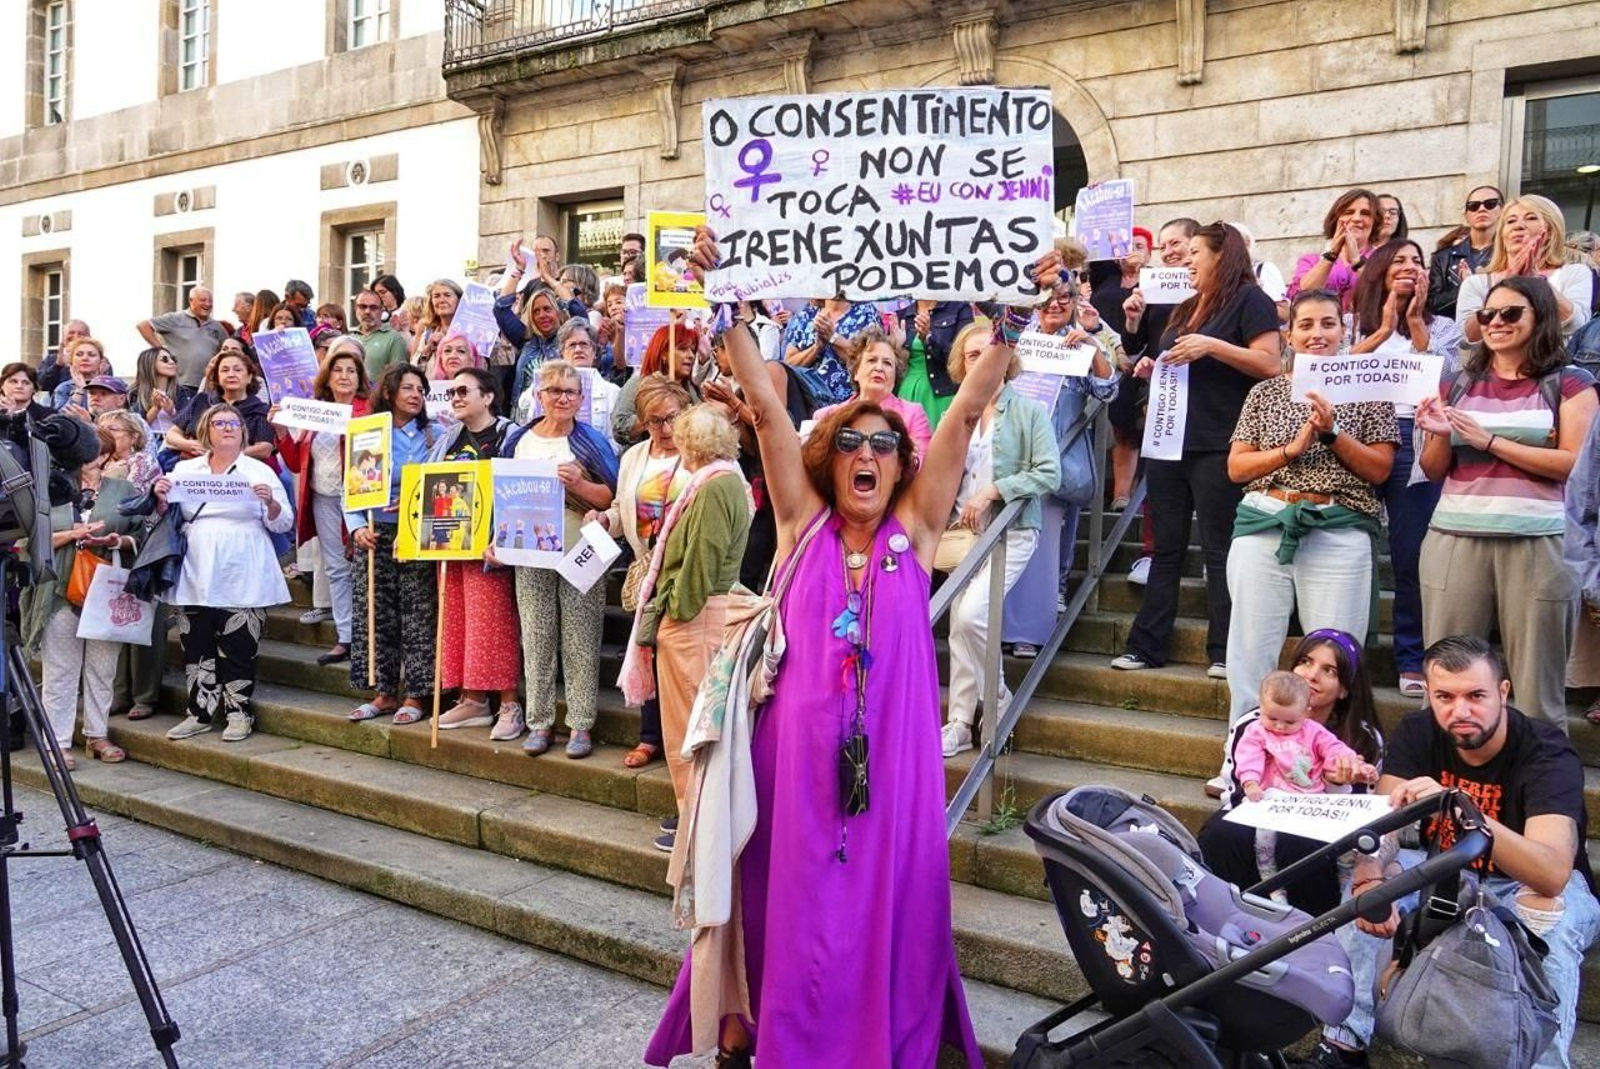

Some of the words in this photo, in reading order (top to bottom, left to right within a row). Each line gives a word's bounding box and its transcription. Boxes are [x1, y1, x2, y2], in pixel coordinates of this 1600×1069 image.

[709, 109, 738, 147] O
[859, 144, 946, 180] NON
[969, 147, 1026, 179] SE
[767, 183, 881, 219] TOCA
[891, 182, 941, 205] #EU
[950, 182, 993, 199] CON
[719, 221, 842, 270] IRENE
[855, 210, 1039, 264] XUNTAS
[821, 258, 1040, 297] PODEMOS
[1160, 282, 1181, 290] POR
[1019, 338, 1053, 349] ONTIGO
[1019, 348, 1033, 357] OR
[1310, 363, 1317, 372] #
[1321, 359, 1380, 373] CONTIGO
[1383, 359, 1424, 374] JENNI,
[1324, 375, 1351, 386] POR
[1355, 373, 1409, 385] TODAS!!
[1153, 393, 1167, 438] CONTIGO
[1160, 365, 1169, 391] JENN
[1168, 371, 1179, 412] TODAS!!
[1165, 414, 1176, 436] POR
[182, 480, 223, 488] CONTIGO
[1267, 805, 1295, 815] POR
[1295, 806, 1350, 821] TODAS!!
